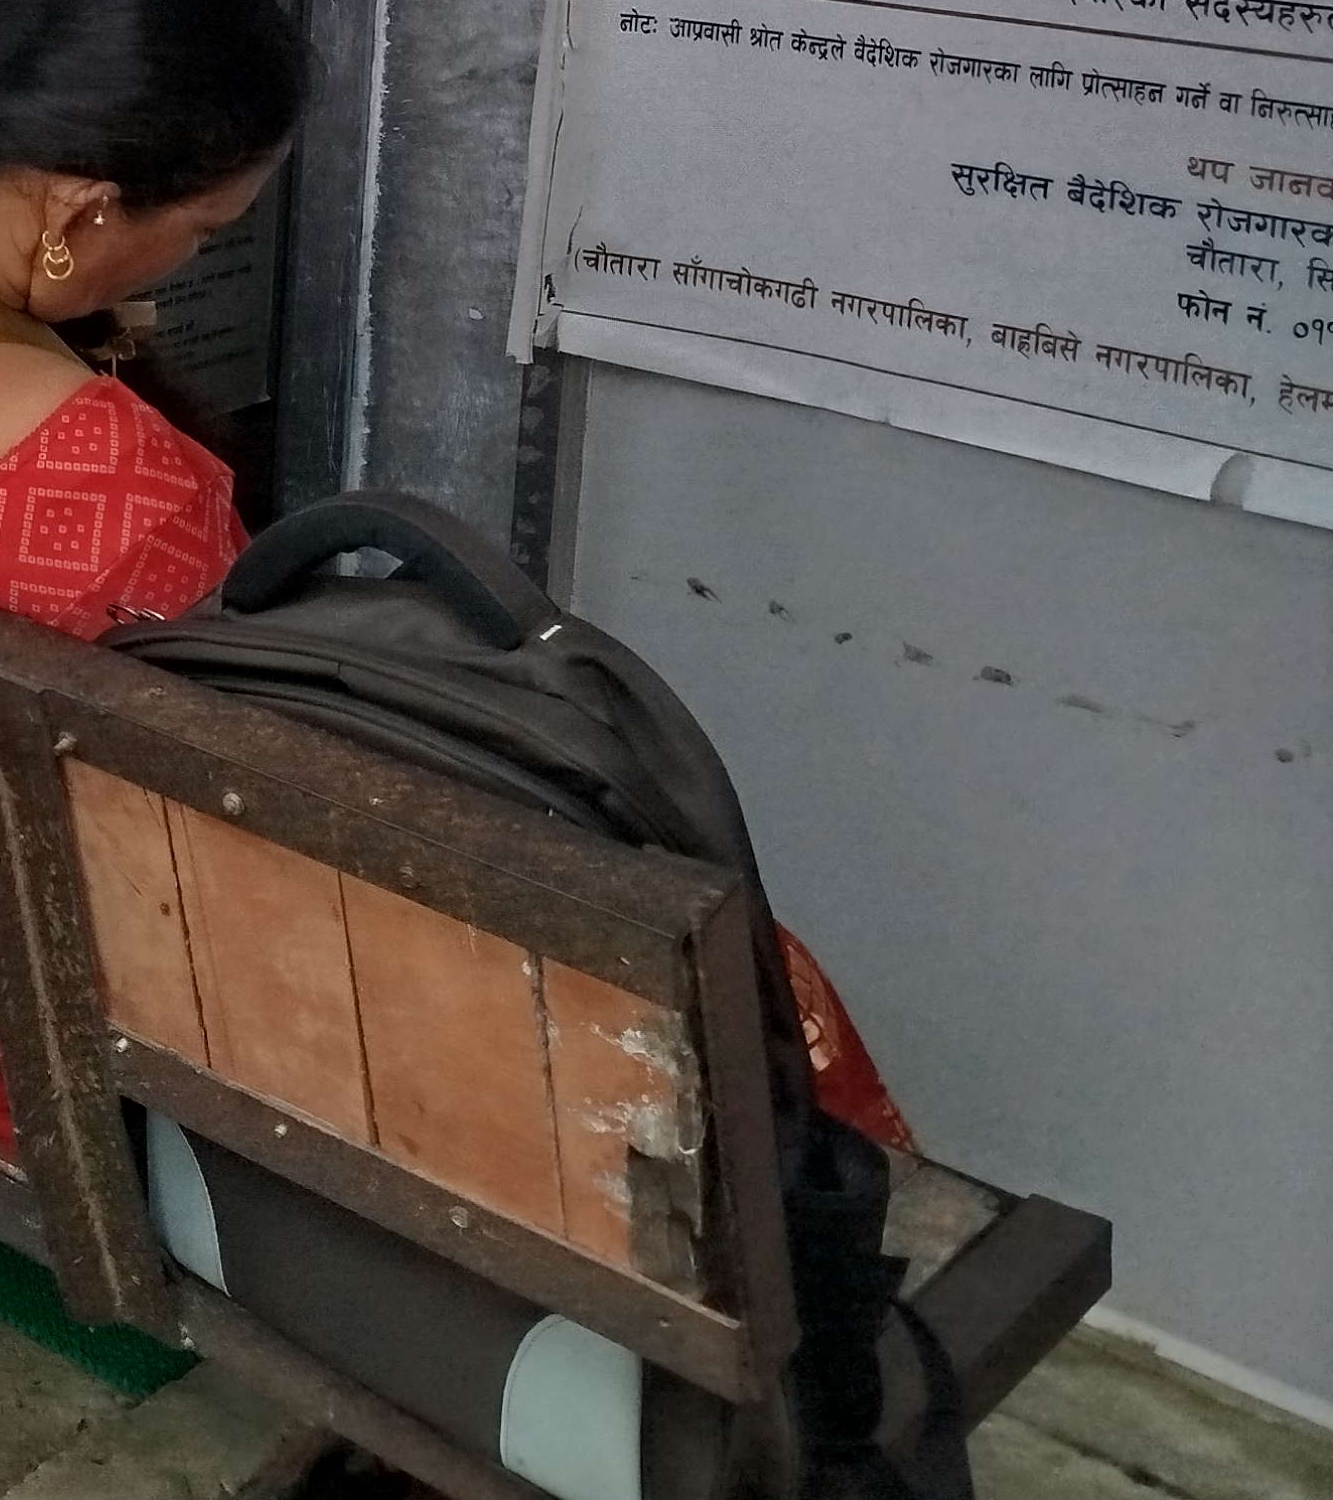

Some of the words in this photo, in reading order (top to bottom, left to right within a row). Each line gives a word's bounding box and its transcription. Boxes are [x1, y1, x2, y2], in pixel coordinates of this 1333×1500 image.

[670, 18, 742, 46] आप्रवासी
[750, 24, 784, 51] श्रोत
[791, 29, 847, 60] केन्द्रले
[855, 35, 921, 68] वैदेशिक
[930, 48, 1021, 83] रोजगारका
[1030, 61, 1073, 90] लागि
[1082, 69, 1166, 105] प्रोत्साहन
[1176, 83, 1210, 108] गर्ने
[1220, 93, 1242, 113] वा
[1251, 89, 1333, 129] निरुत्सा
[951, 162, 1054, 200] सुरक्षित
[1188, 157, 1235, 183] थप
[1178, 290, 1232, 324] फोन
